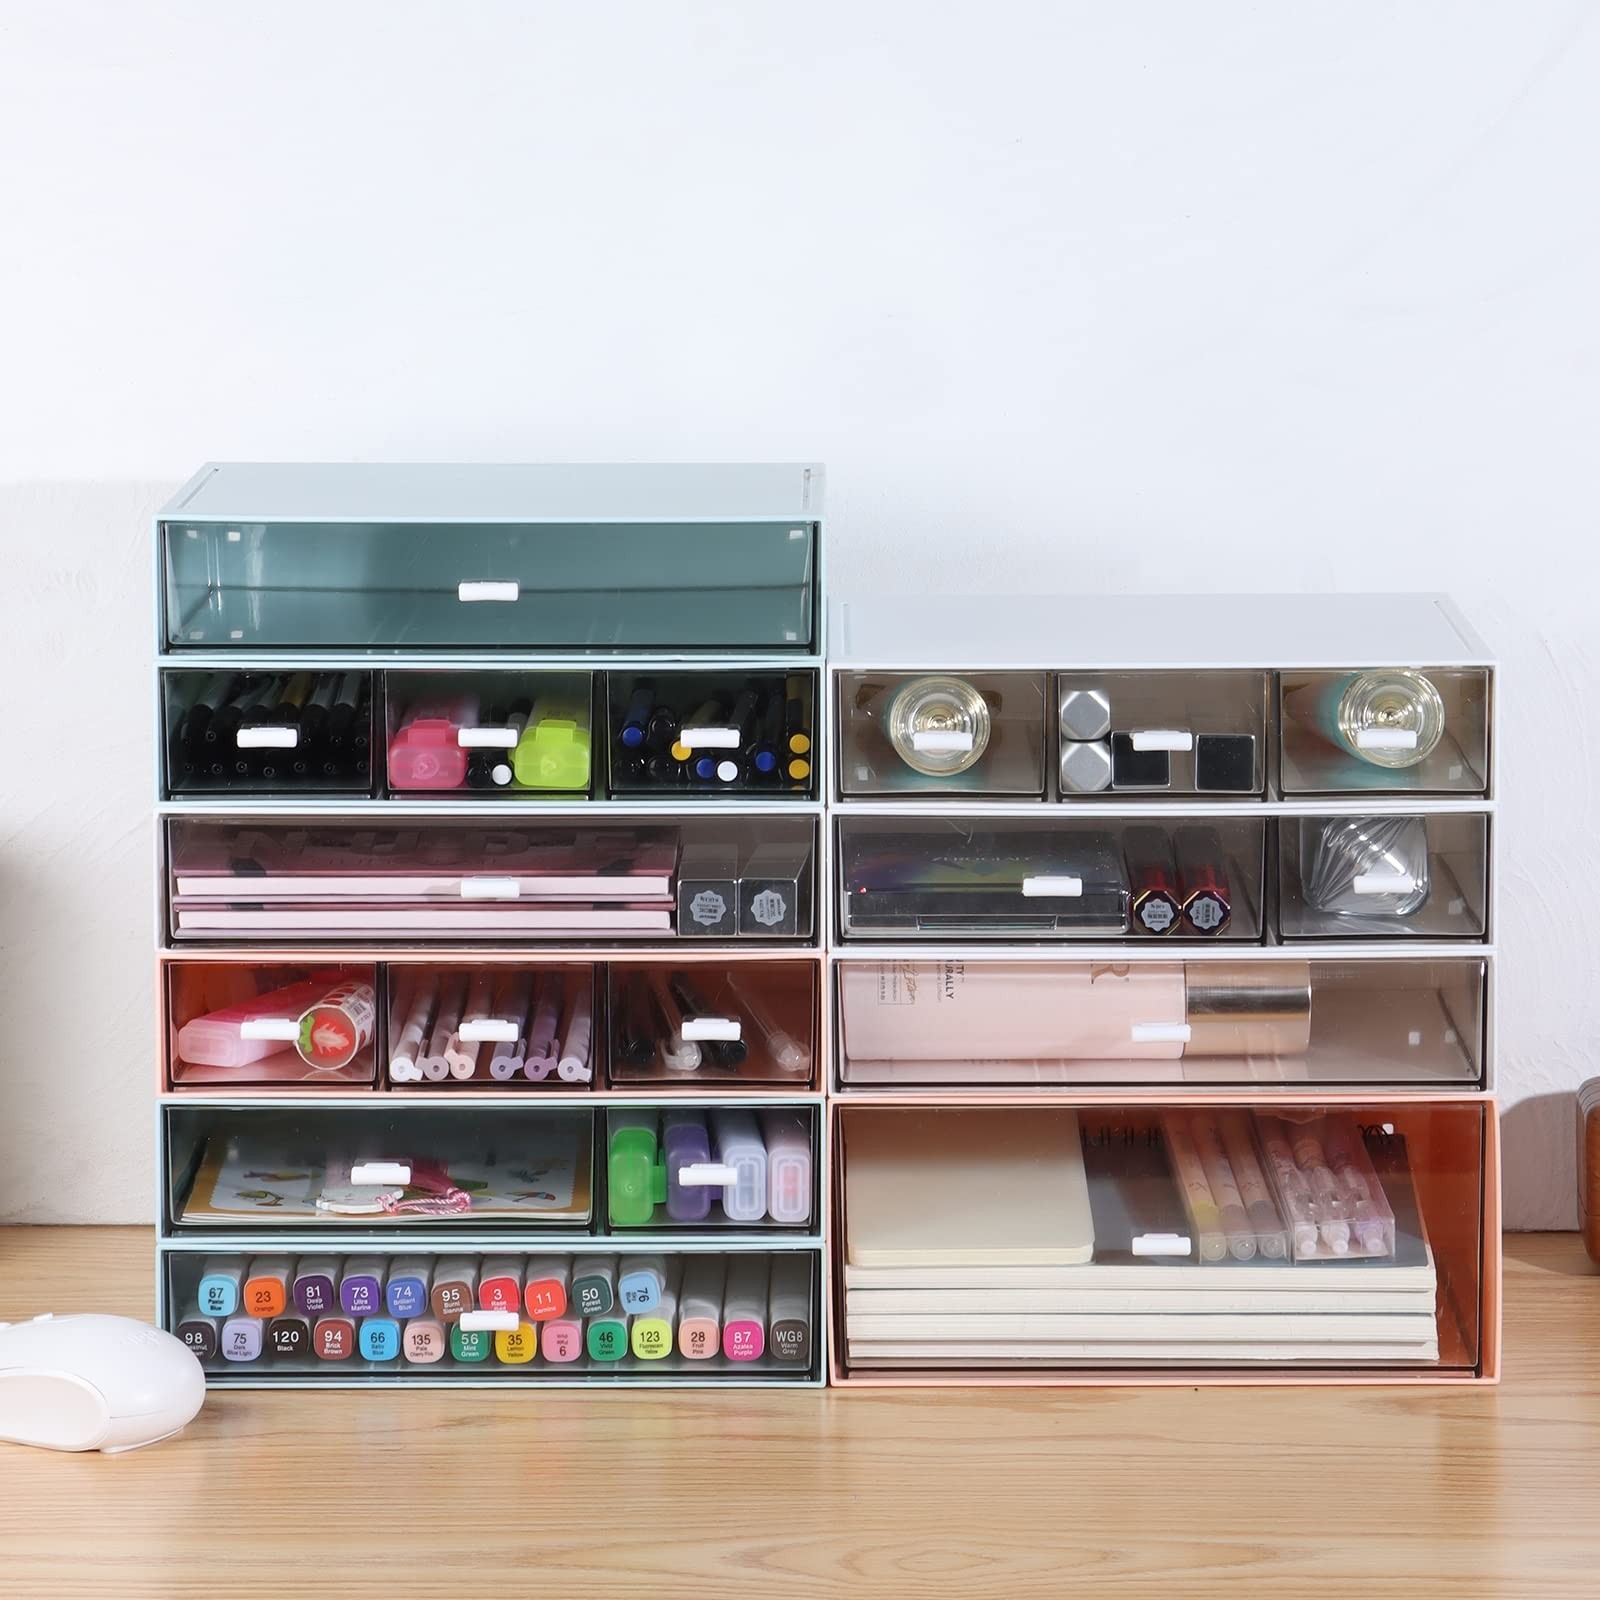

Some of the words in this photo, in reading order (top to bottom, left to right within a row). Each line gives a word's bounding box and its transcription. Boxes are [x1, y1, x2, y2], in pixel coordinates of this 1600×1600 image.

[209, 1287, 224, 1299] 67
[255, 1291, 271, 1304] 23
[306, 1285, 320, 1298] 81
[352, 1286, 369, 1299] 73
[394, 1286, 412, 1299] 74
[442, 1289, 460, 1302] 95
[493, 1288, 502, 1301] 3
[582, 1288, 599, 1300] 50
[637, 1288, 650, 1303] 76
[536, 1292, 552, 1305] 11
[581, 1299, 601, 1307] Forest
[442, 1307, 464, 1315] Sienna
[534, 1306, 556, 1314] Carmine
[583, 1305, 602, 1313] Green
[185, 1332, 203, 1344] 98
[233, 1333, 247, 1344] 75
[272, 1331, 299, 1343] 120
[324, 1331, 342, 1342] 94
[370, 1332, 385, 1343] 66
[411, 1334, 431, 1346] 135
[461, 1333, 479, 1345] 56
[508, 1334, 523, 1346] 35
[599, 1331, 614, 1343] 46
[640, 1331, 661, 1343] 123
[691, 1332, 706, 1343] 28
[734, 1332, 752, 1344] 87
[775, 1330, 804, 1343] WG8
[733, 1349, 753, 1357] Purple
